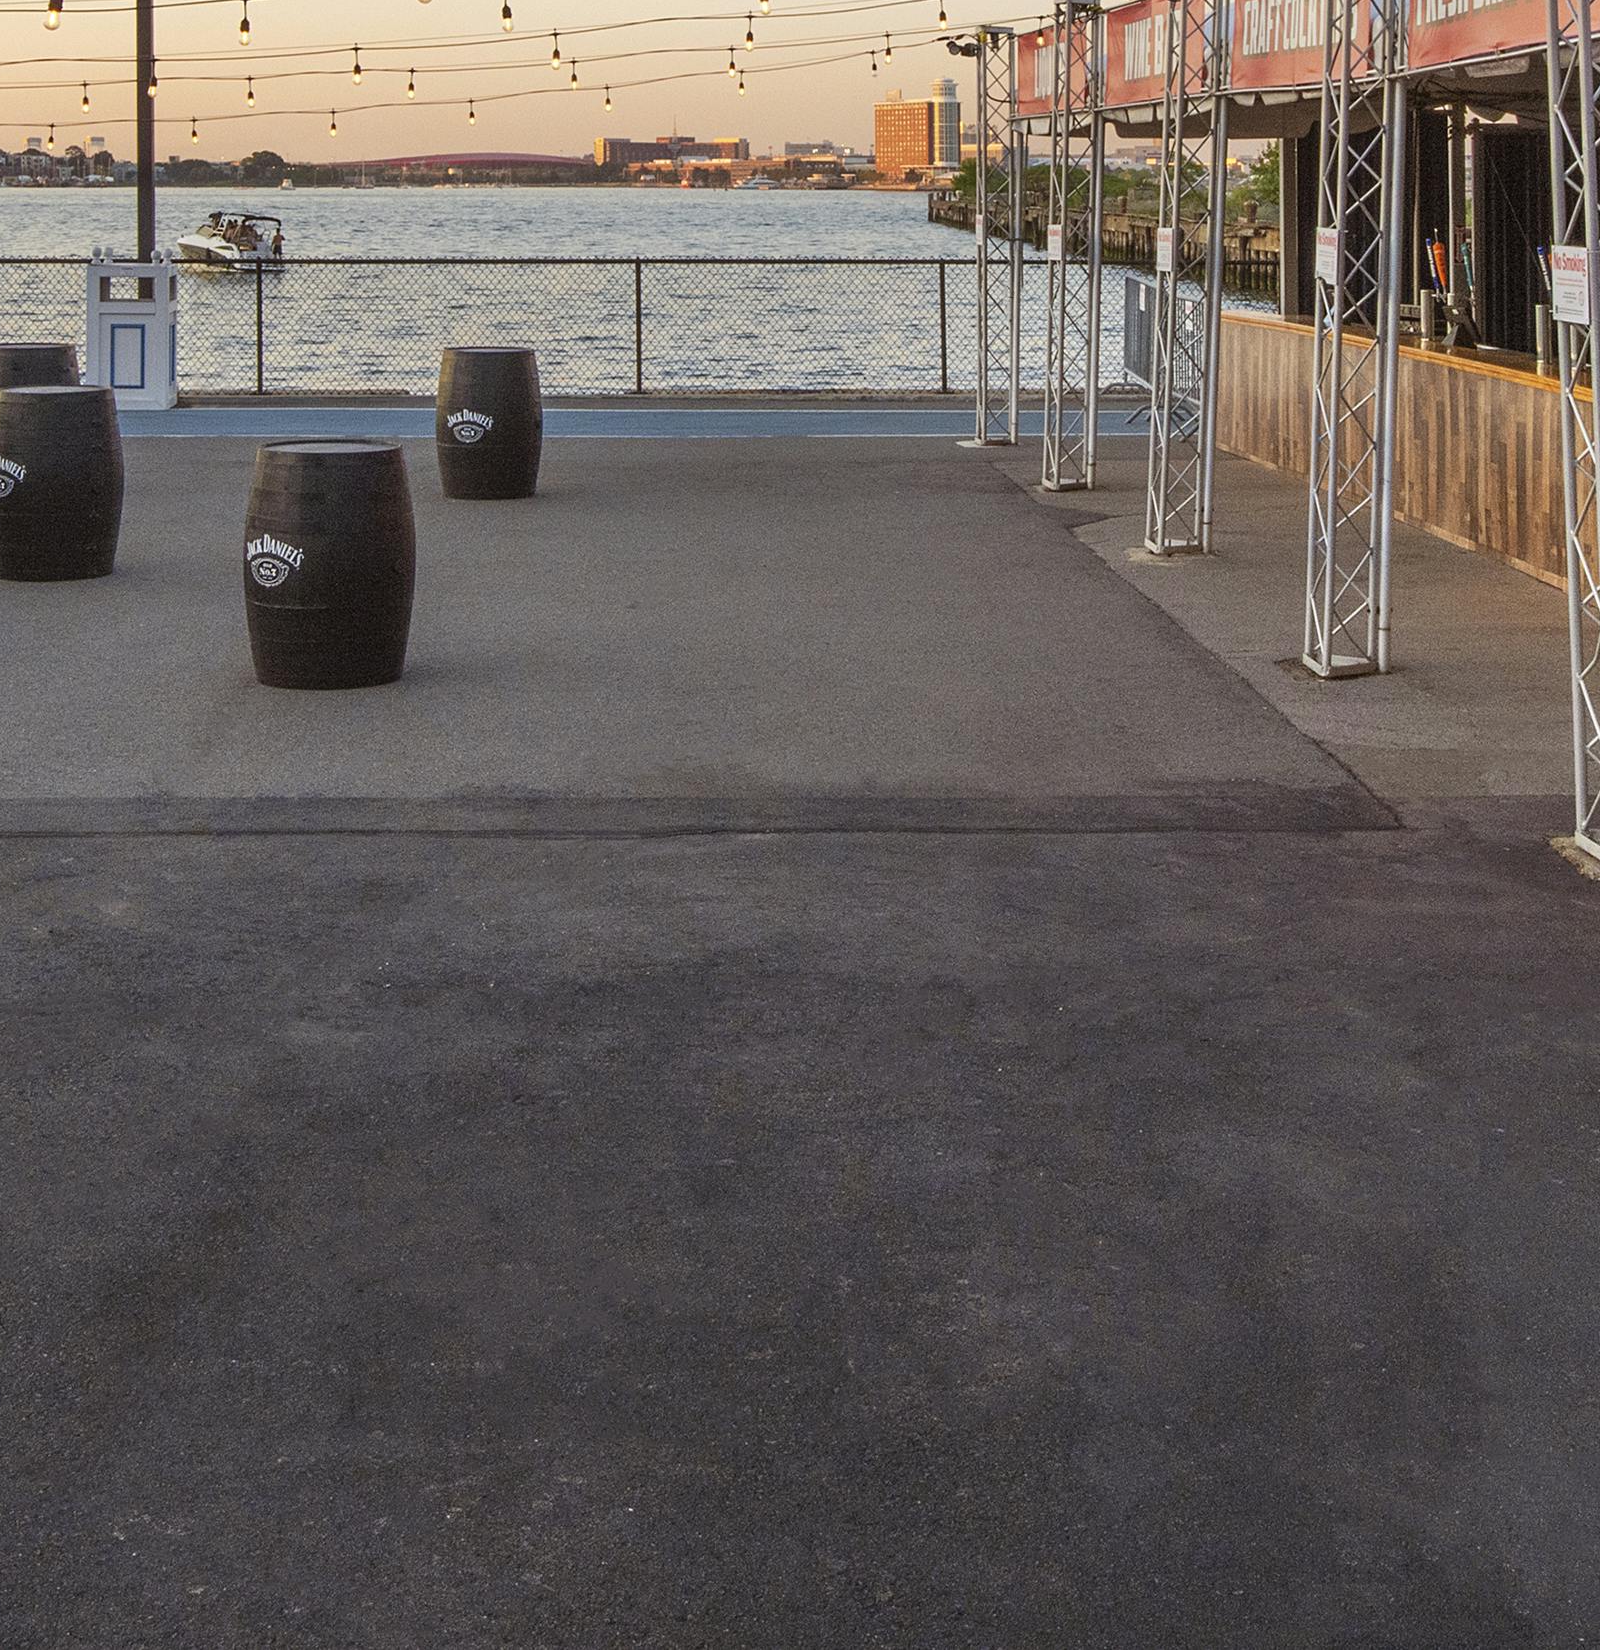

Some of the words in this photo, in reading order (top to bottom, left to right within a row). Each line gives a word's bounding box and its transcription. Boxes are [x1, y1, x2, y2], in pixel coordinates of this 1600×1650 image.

[447, 411, 463, 428] JACK
[246, 538, 263, 561] JACK
[263, 533, 305, 568] DANIEL'S
